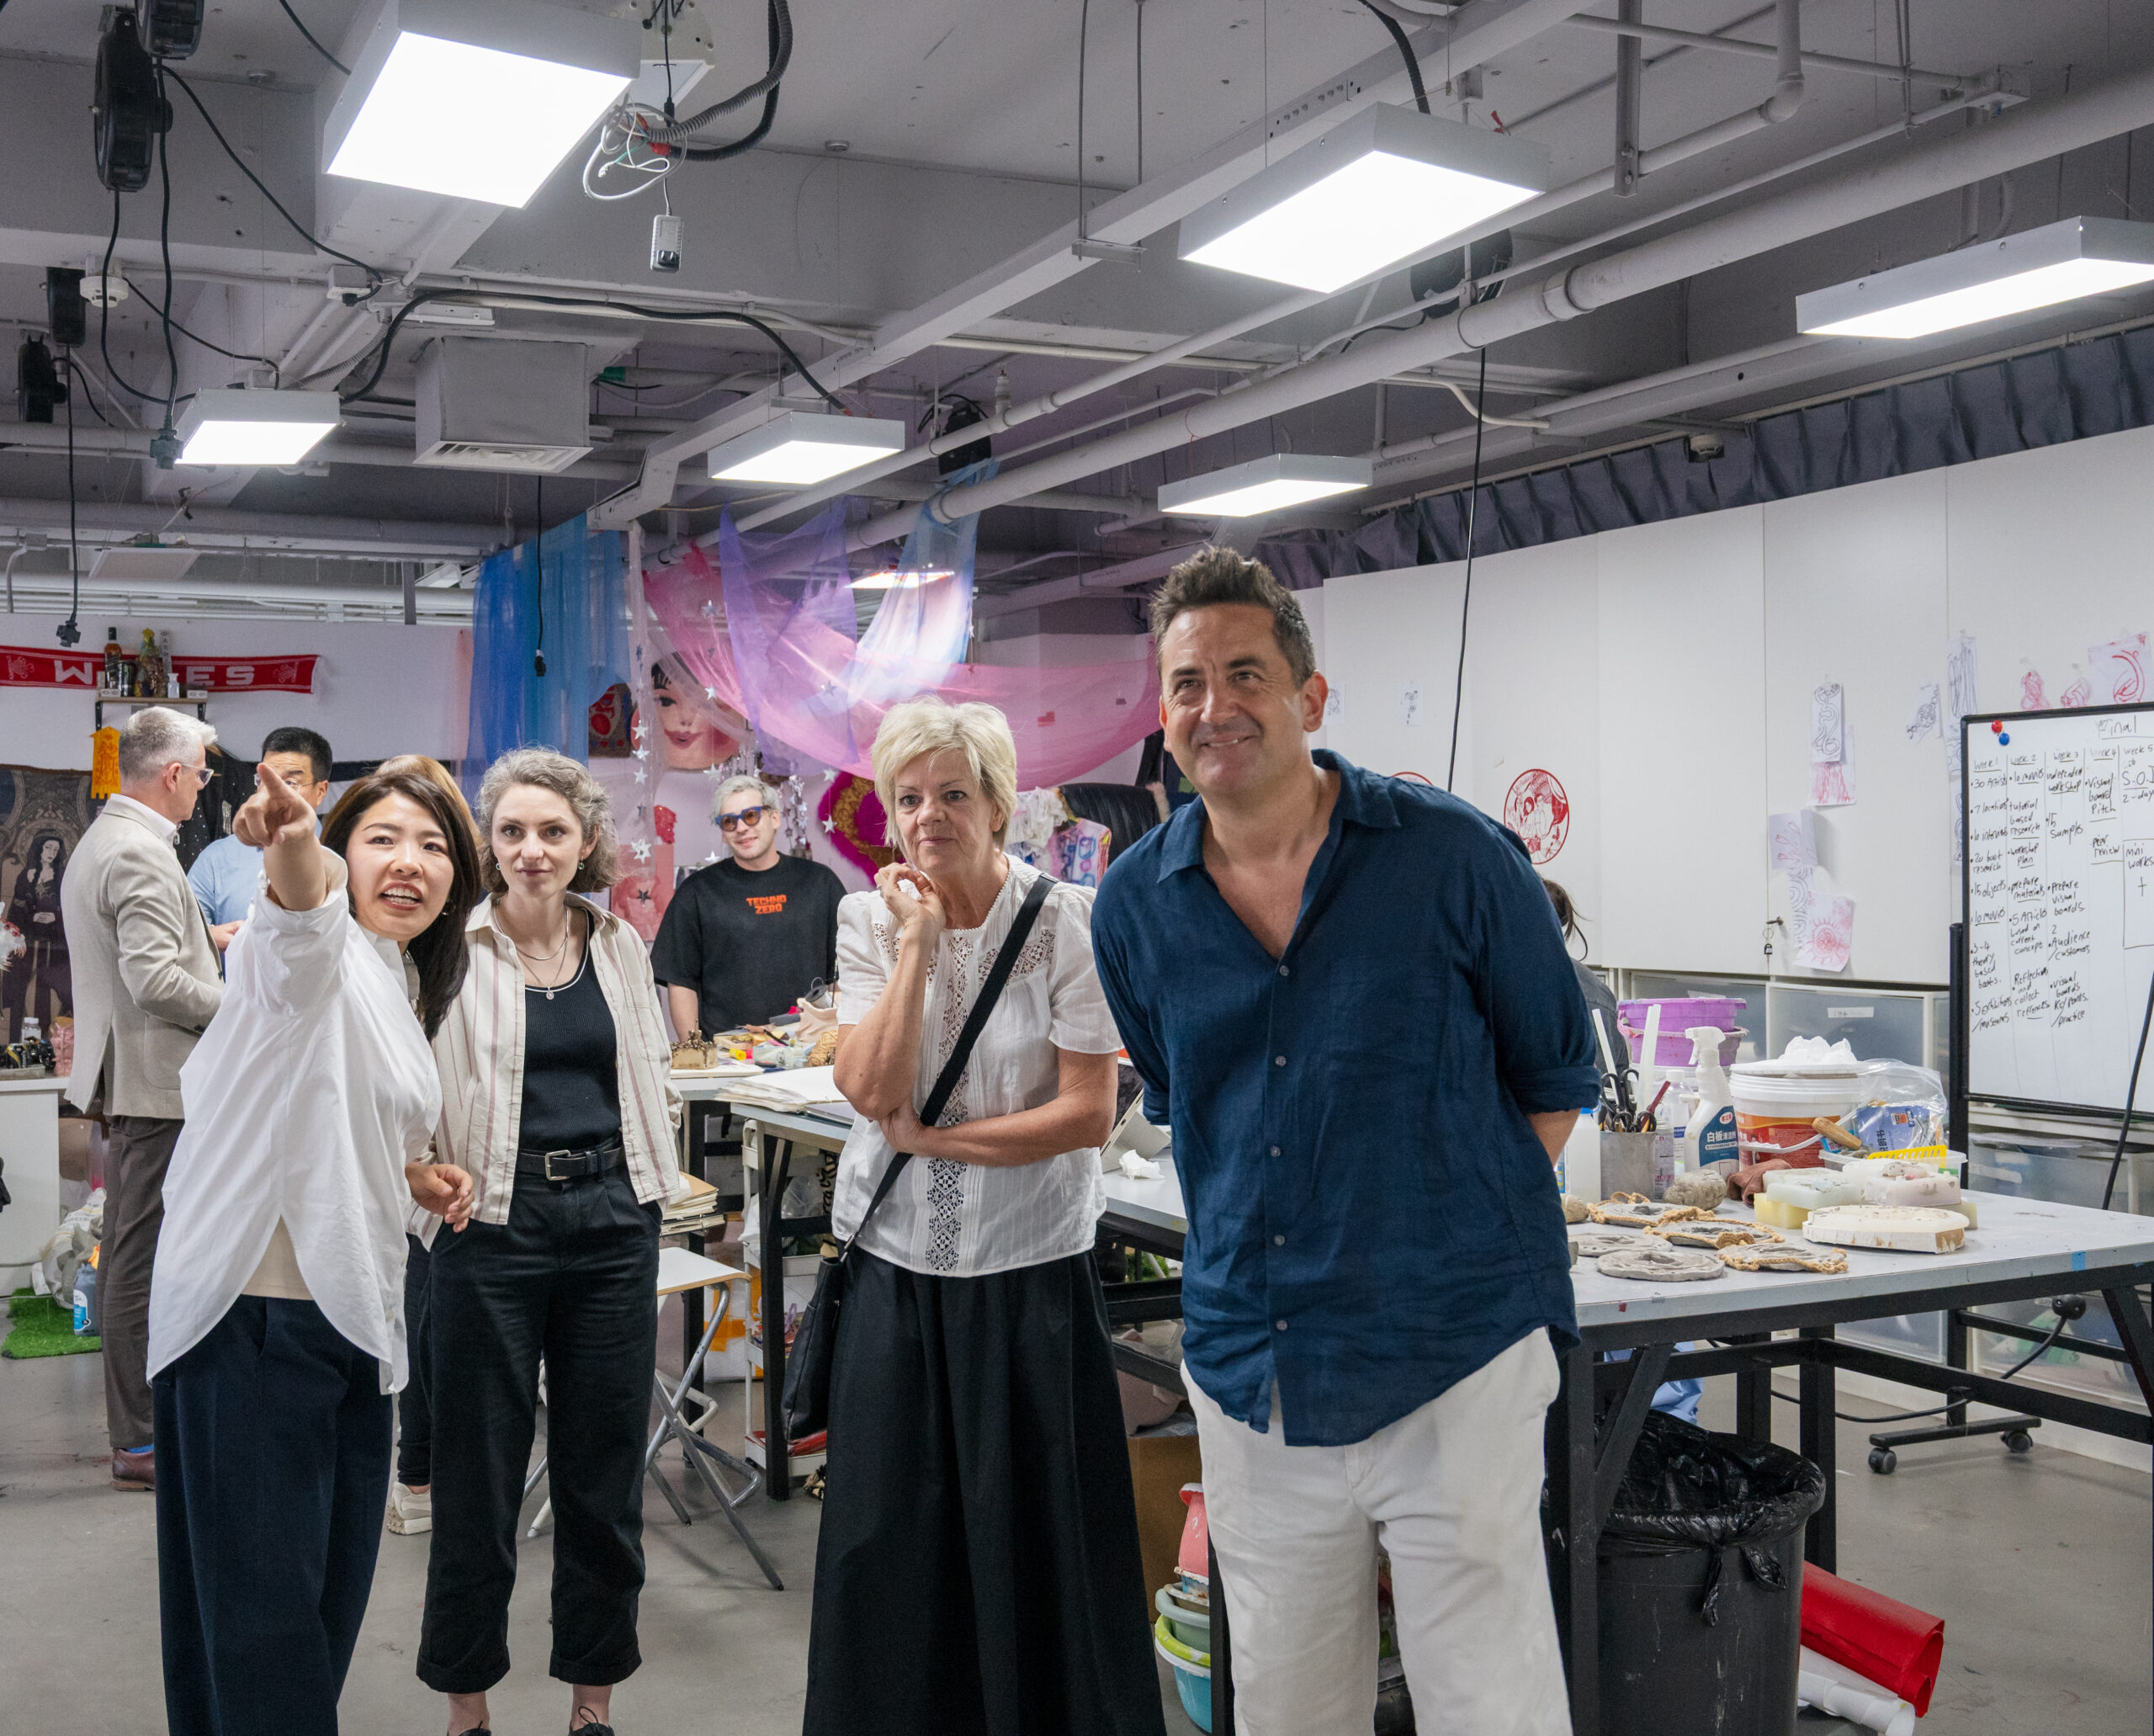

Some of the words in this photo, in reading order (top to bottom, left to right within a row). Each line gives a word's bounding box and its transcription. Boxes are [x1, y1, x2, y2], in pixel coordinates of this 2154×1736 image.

[54, 659, 255, 687] WES
[745, 894, 788, 907] TECHNO
[754, 902, 783, 915] ZERO
